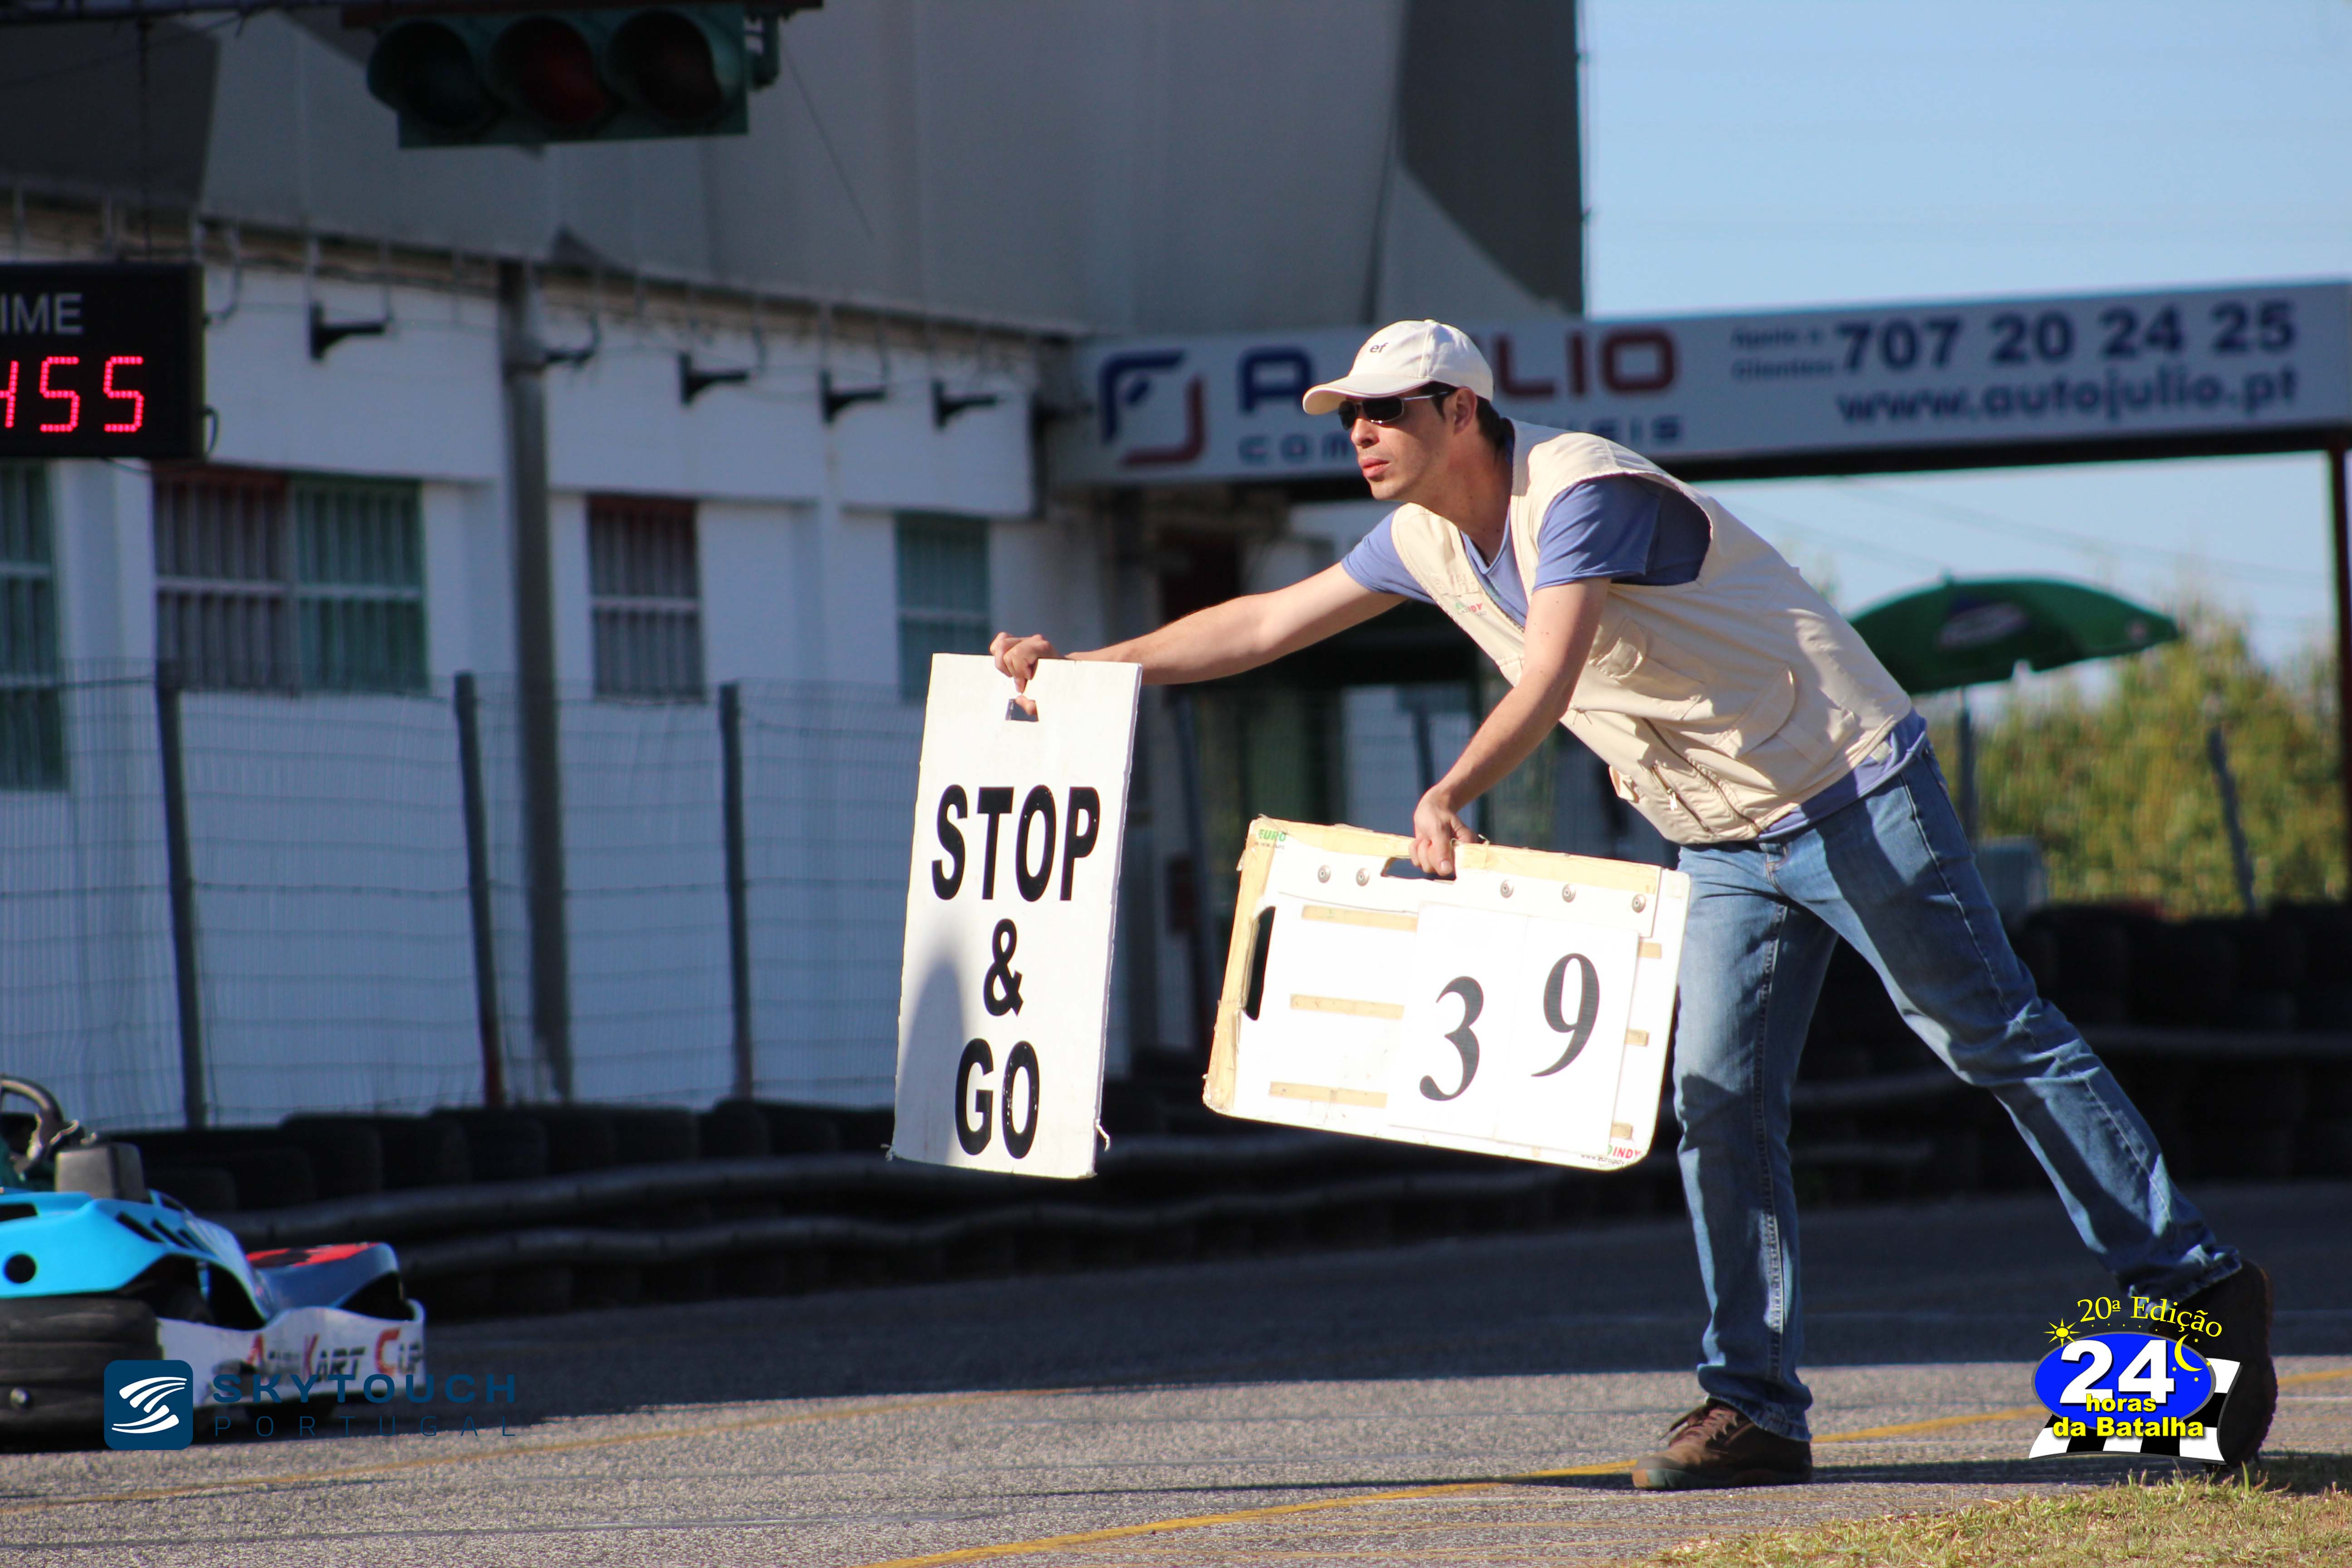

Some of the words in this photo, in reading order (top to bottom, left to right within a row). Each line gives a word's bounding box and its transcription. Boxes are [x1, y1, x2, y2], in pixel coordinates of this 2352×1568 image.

[1837, 317, 1961, 370] 707
[1989, 309, 2074, 363] 20
[2098, 304, 2183, 356] 24
[2210, 299, 2296, 352] 25
[1837, 365, 2297, 423] www.autojulio.pt
[931, 784, 1100, 902] STOP
[983, 918, 1024, 1017] &
[955, 1037, 1040, 1160] GO
